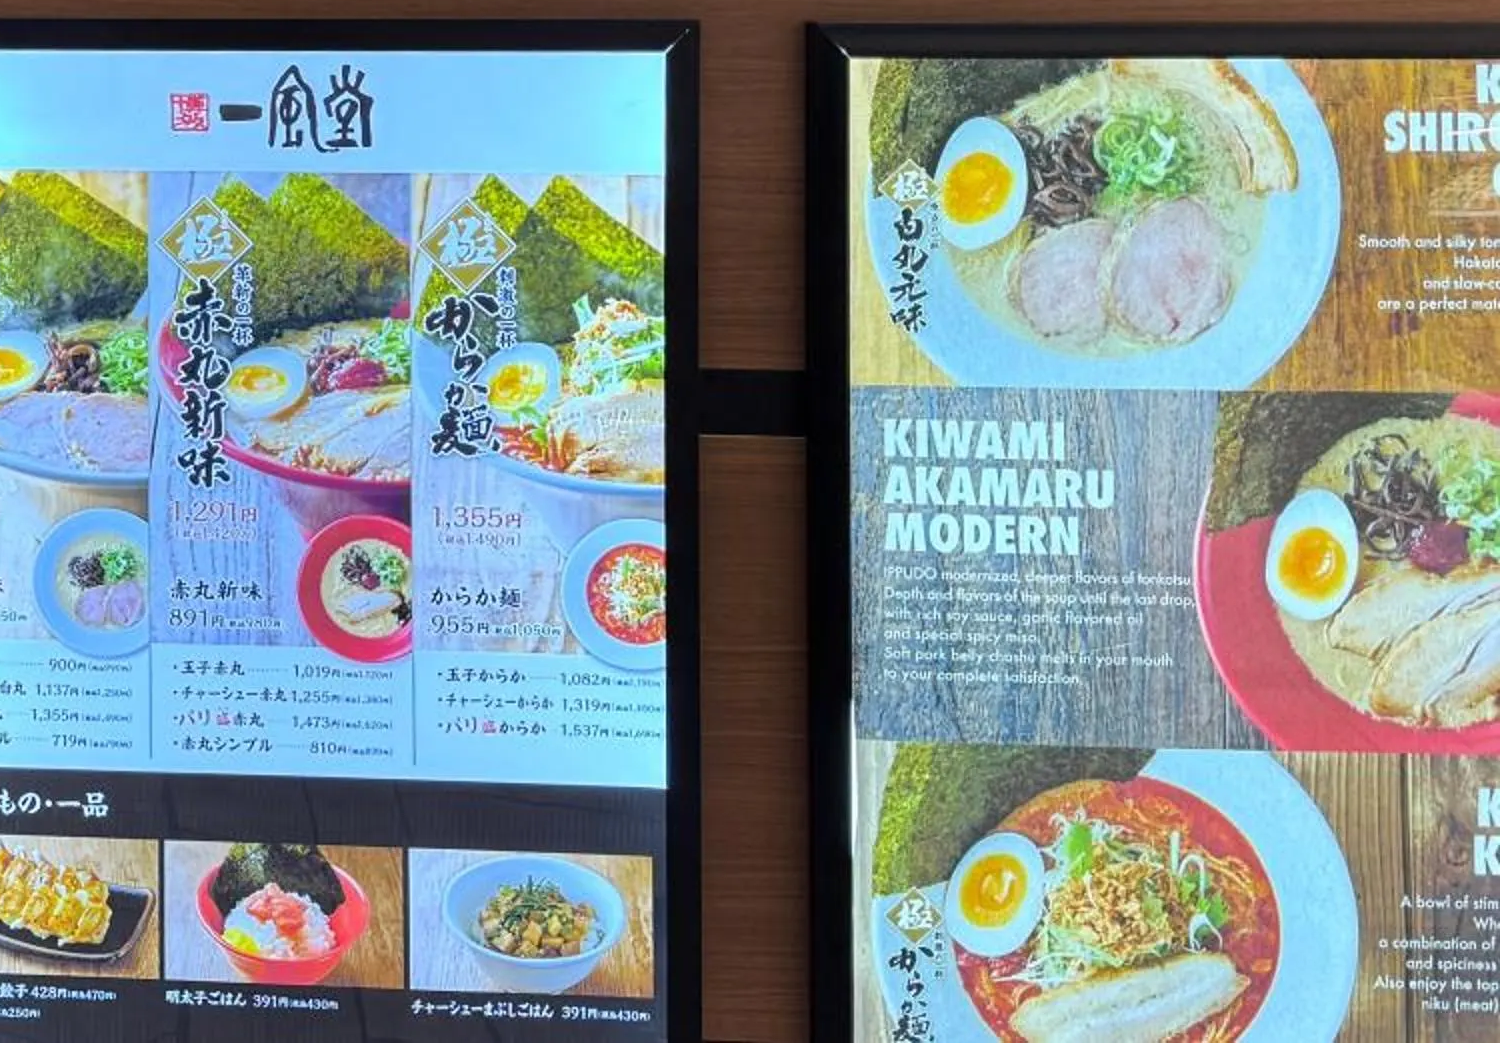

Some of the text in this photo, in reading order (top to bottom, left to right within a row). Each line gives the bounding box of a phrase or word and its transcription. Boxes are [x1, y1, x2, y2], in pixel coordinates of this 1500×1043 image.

[1358, 234, 1410, 250] Smooth
[1415, 233, 1441, 249] and
[1423, 274, 1450, 290] and
[1377, 299, 1401, 311] are
[1419, 294, 1467, 313] perfect
[883, 418, 1065, 461] KIWAMI
[883, 465, 1115, 509] AKAMARU
[172, 500, 257, 524] 1,291円
[432, 505, 522, 530] 1,355円
[883, 512, 1082, 556] MODERN
[883, 566, 937, 580] IPPUDO
[1075, 568, 1118, 584] flavors
[1121, 571, 1135, 584] of
[170, 578, 262, 601] 赤丸新味
[431, 585, 521, 608] からか麺
[883, 586, 924, 603] Depth
[927, 588, 953, 601] and
[956, 587, 1001, 602] flavors
[1003, 588, 1017, 602] of
[1020, 589, 1041, 603] the
[1160, 592, 1196, 609] drop,
[884, 628, 911, 640] and
[883, 646, 911, 659] Soft
[915, 647, 945, 662] pork
[1096, 654, 1129, 668] your
[1131, 653, 1173, 667] mouth
[180, 660, 244, 677] 玉子赤丸
[446, 667, 526, 684] 玉子からか
[883, 668, 897, 680] to
[901, 669, 932, 684] your
[937, 669, 999, 686] complete
[1400, 894, 1500, 911] A bowl of stim
[1379, 935, 1497, 951] a combination of
[1406, 957, 1498, 976] and spiciness
[1373, 975, 1405, 991] Also
[1409, 975, 1447, 996] enjoy
[1451, 975, 1472, 991] the
[165, 989, 247, 1007] 明太子ごはん
[1421, 996, 1499, 1015] niku (meat)
